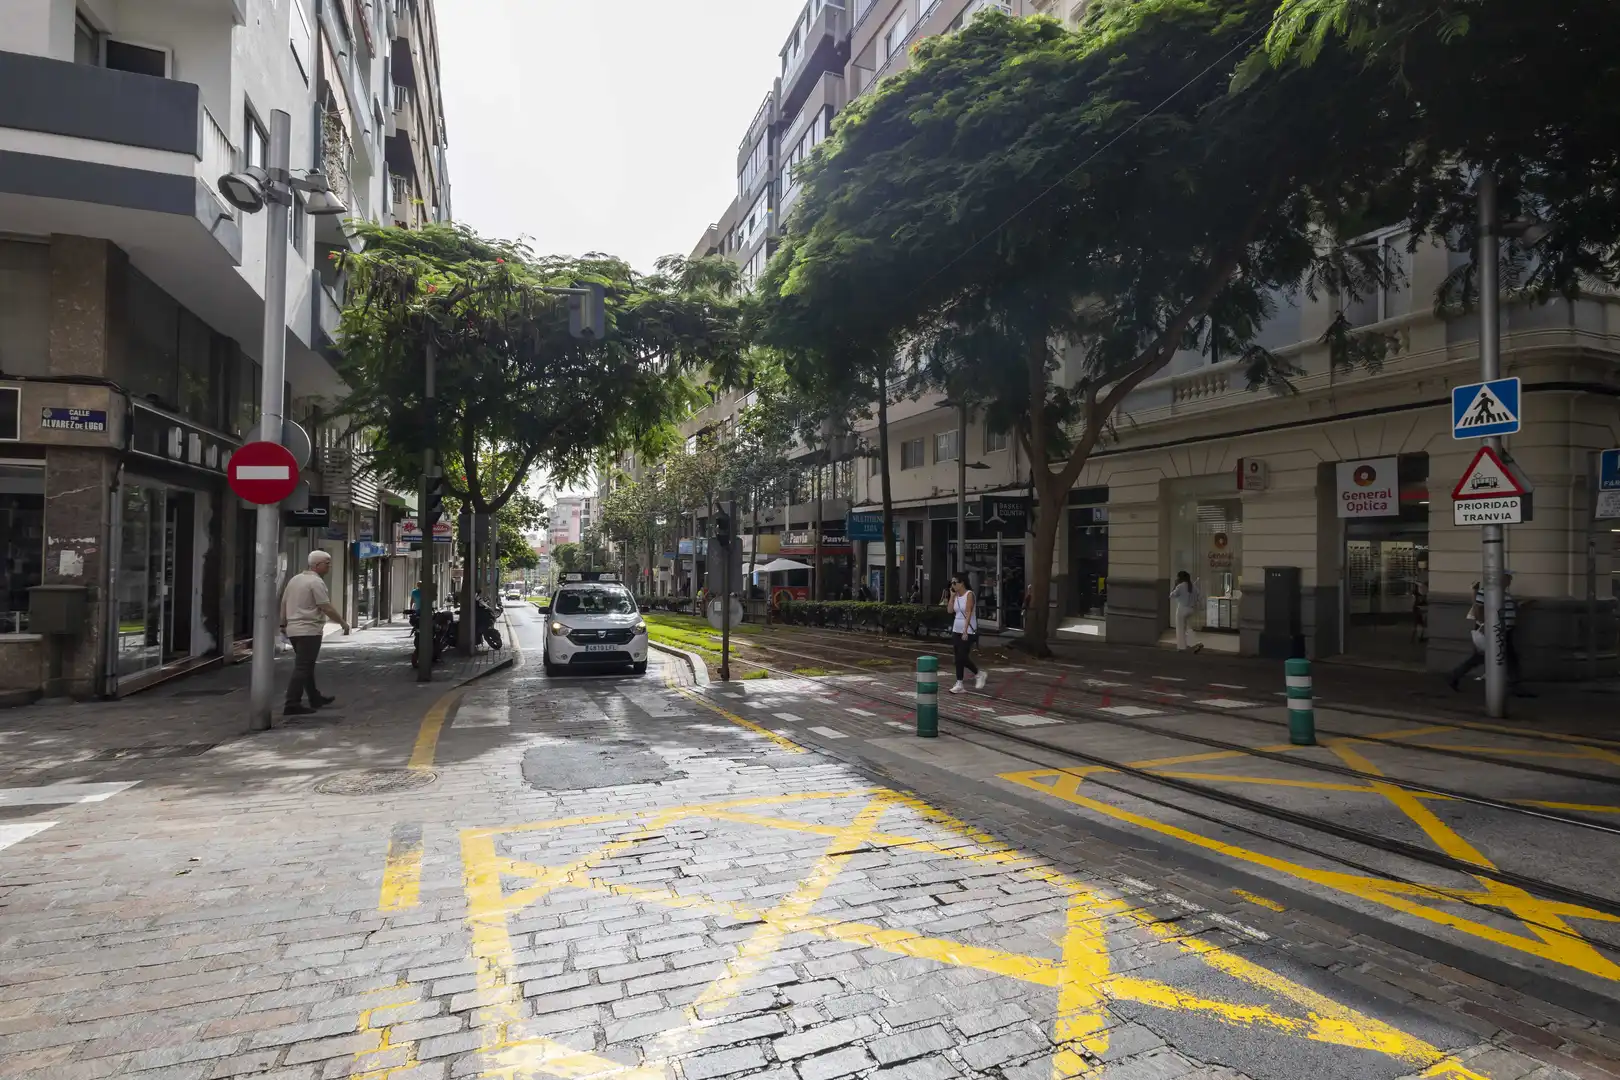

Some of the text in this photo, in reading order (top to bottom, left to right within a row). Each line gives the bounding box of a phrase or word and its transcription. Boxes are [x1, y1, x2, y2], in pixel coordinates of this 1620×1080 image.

[69, 409, 90, 417] CALLE
[42, 419, 75, 429] ALVAREZ
[85, 422, 103, 431] LUGO
[1342, 487, 1392, 501] General
[1346, 500, 1388, 513] Optica
[1457, 500, 1518, 511] PRIORIDAD
[1463, 513, 1512, 522] TRANVIA
